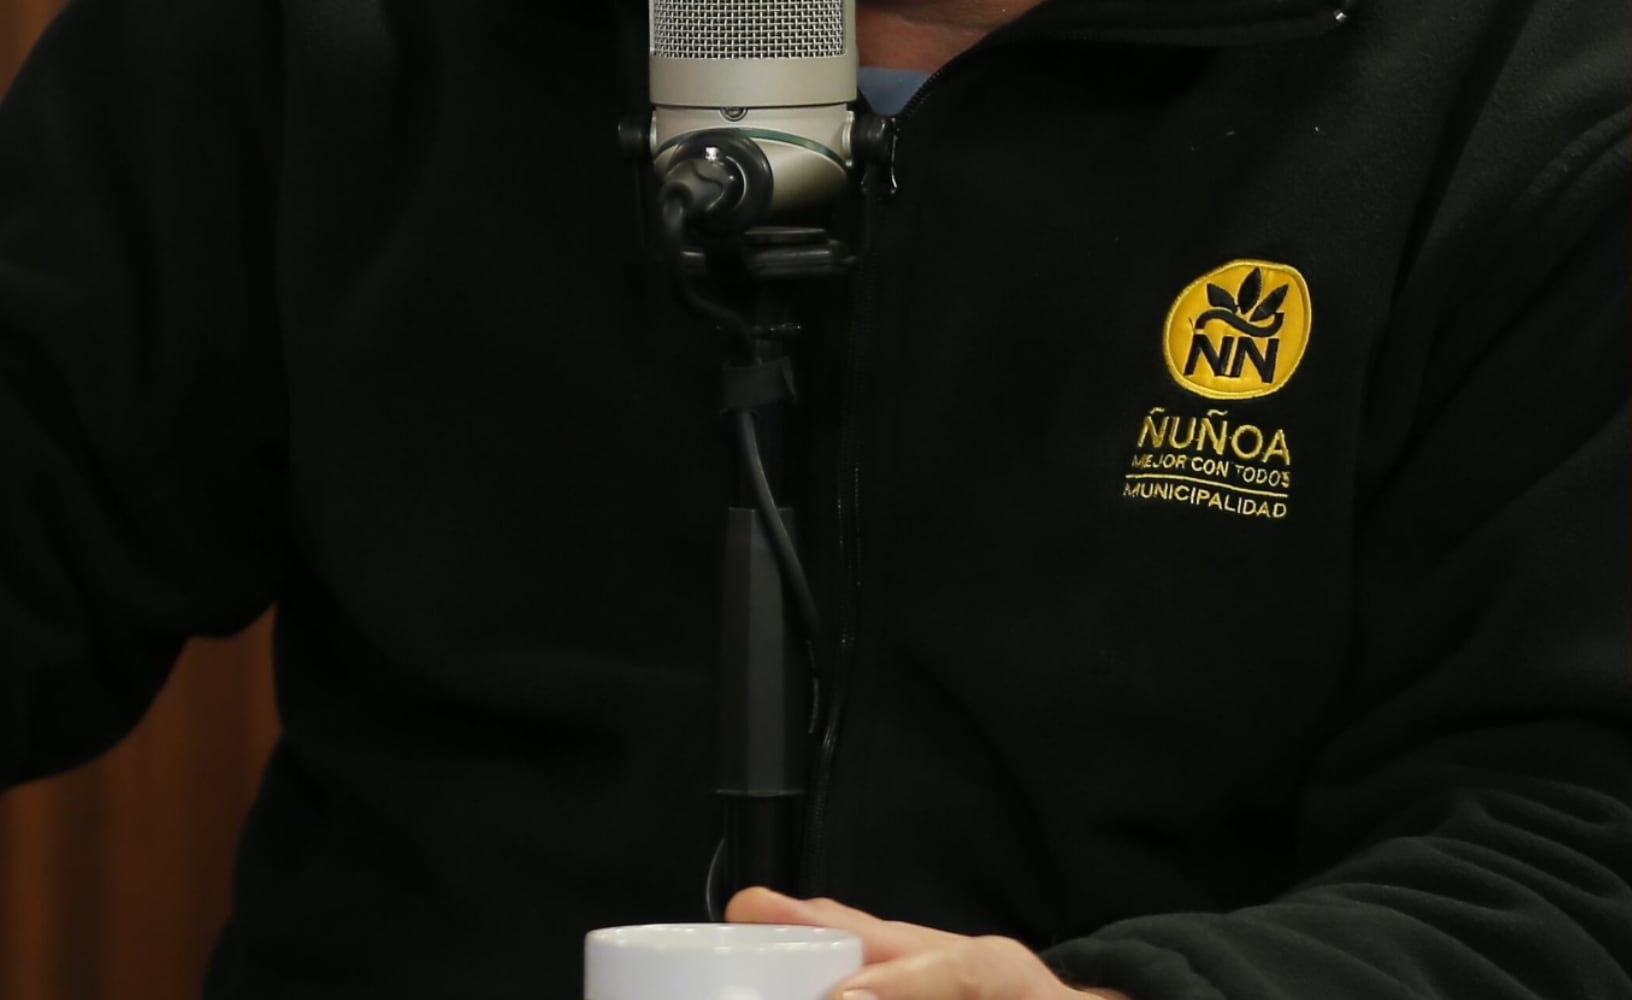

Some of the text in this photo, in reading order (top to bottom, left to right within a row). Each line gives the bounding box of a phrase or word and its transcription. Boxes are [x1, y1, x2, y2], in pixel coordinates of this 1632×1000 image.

[1137, 406, 1291, 466] ÑUÑOA
[1131, 453, 1291, 488] MEJOR CON TODOS
[1123, 481, 1288, 519] MUNICIPALIDAD
